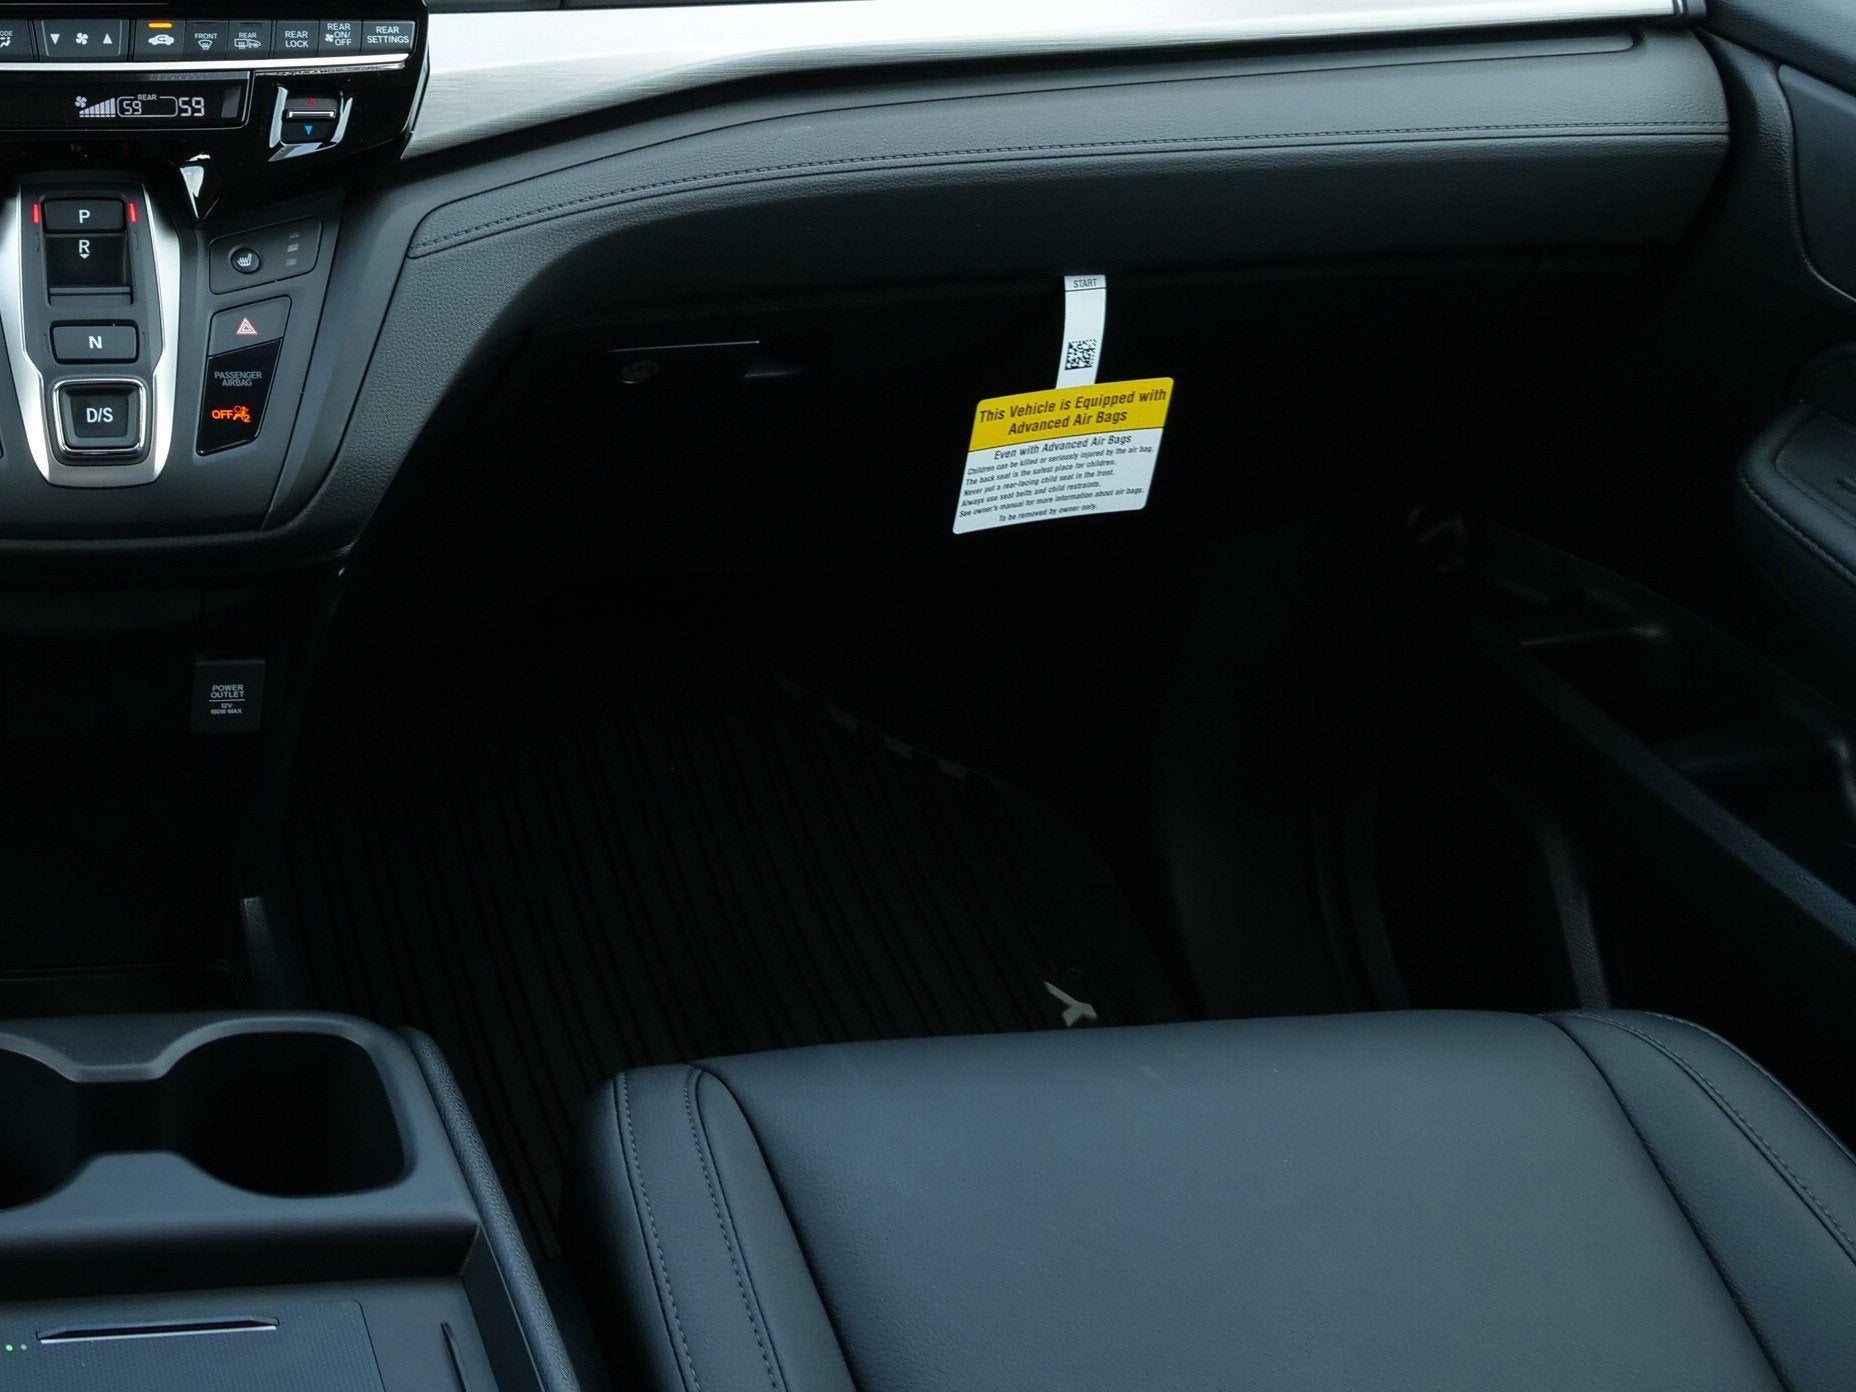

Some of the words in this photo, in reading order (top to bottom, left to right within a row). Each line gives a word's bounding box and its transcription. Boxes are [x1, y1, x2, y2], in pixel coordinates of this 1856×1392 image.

[123, 101, 141, 114] 59
[179, 98, 204, 116] 59
[79, 210, 90, 223] P
[79, 240, 90, 253] R
[1073, 278, 1097, 288] START
[89, 336, 102, 348] N
[222, 379, 252, 387] AIRBAG
[979, 409, 1005, 423] This
[1010, 403, 1055, 418] Vehicle
[1060, 399, 1070, 411] is
[1075, 391, 1134, 410] Equipped
[1139, 389, 1166, 402] with
[87, 408, 113, 422] D/S
[212, 410, 234, 419] OFF
[1008, 415, 1069, 436] Advanced
[1073, 413, 1092, 426] Air
[1096, 410, 1128, 424] Bags
[994, 449, 1017, 460] Even
[1020, 446, 1039, 456] with
[1042, 438, 1087, 452] Advanced
[1091, 436, 1106, 446] Air
[1108, 434, 1132, 446] Bags
[968, 466, 994, 475] Children
[1020, 458, 1038, 466] killed
